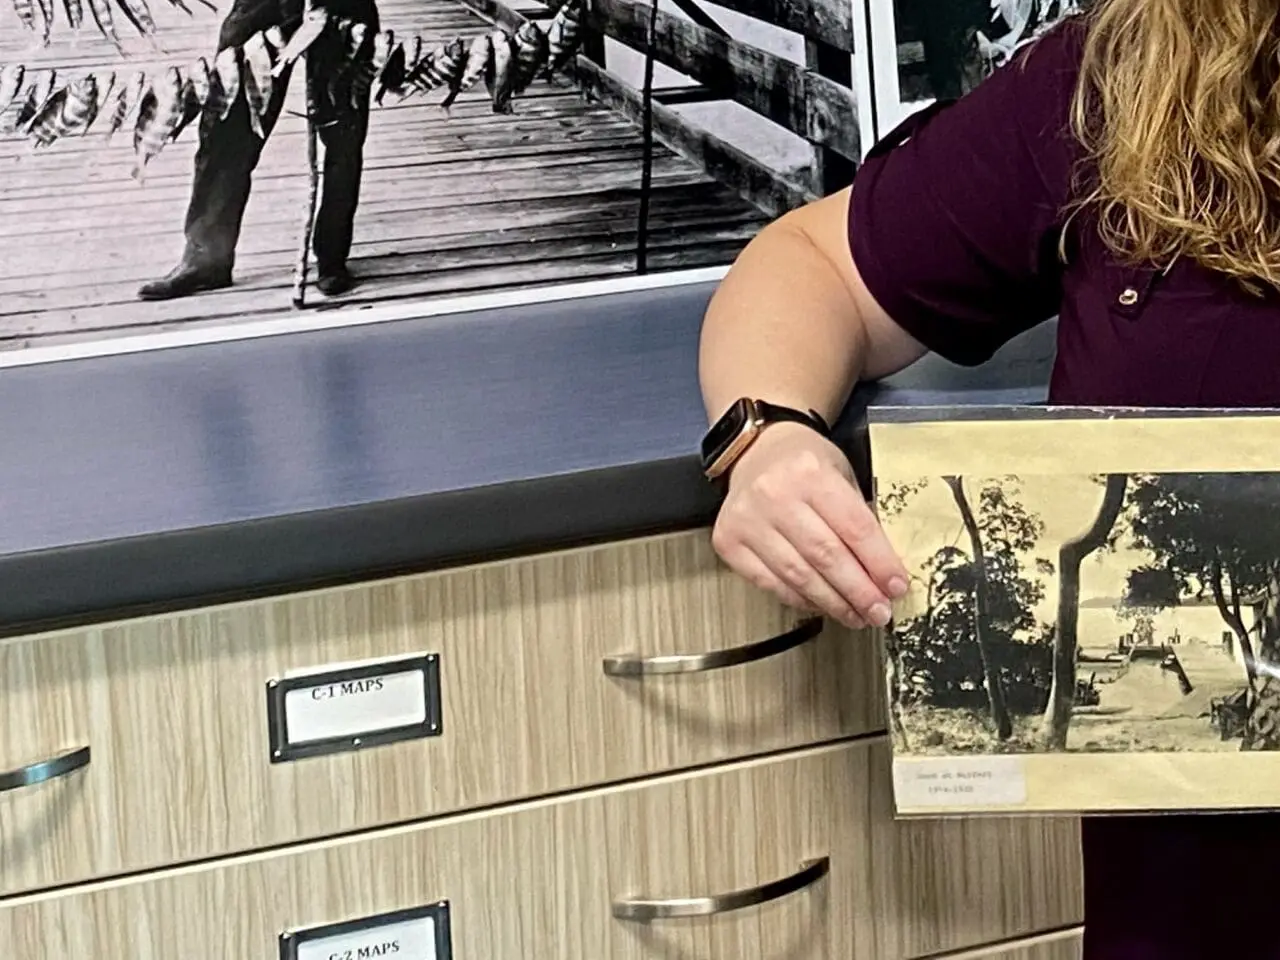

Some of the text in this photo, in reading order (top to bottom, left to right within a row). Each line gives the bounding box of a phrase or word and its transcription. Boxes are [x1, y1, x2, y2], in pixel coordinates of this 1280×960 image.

[312, 677, 384, 700] C-1 MAPS
[357, 939, 400, 960] MAPS
